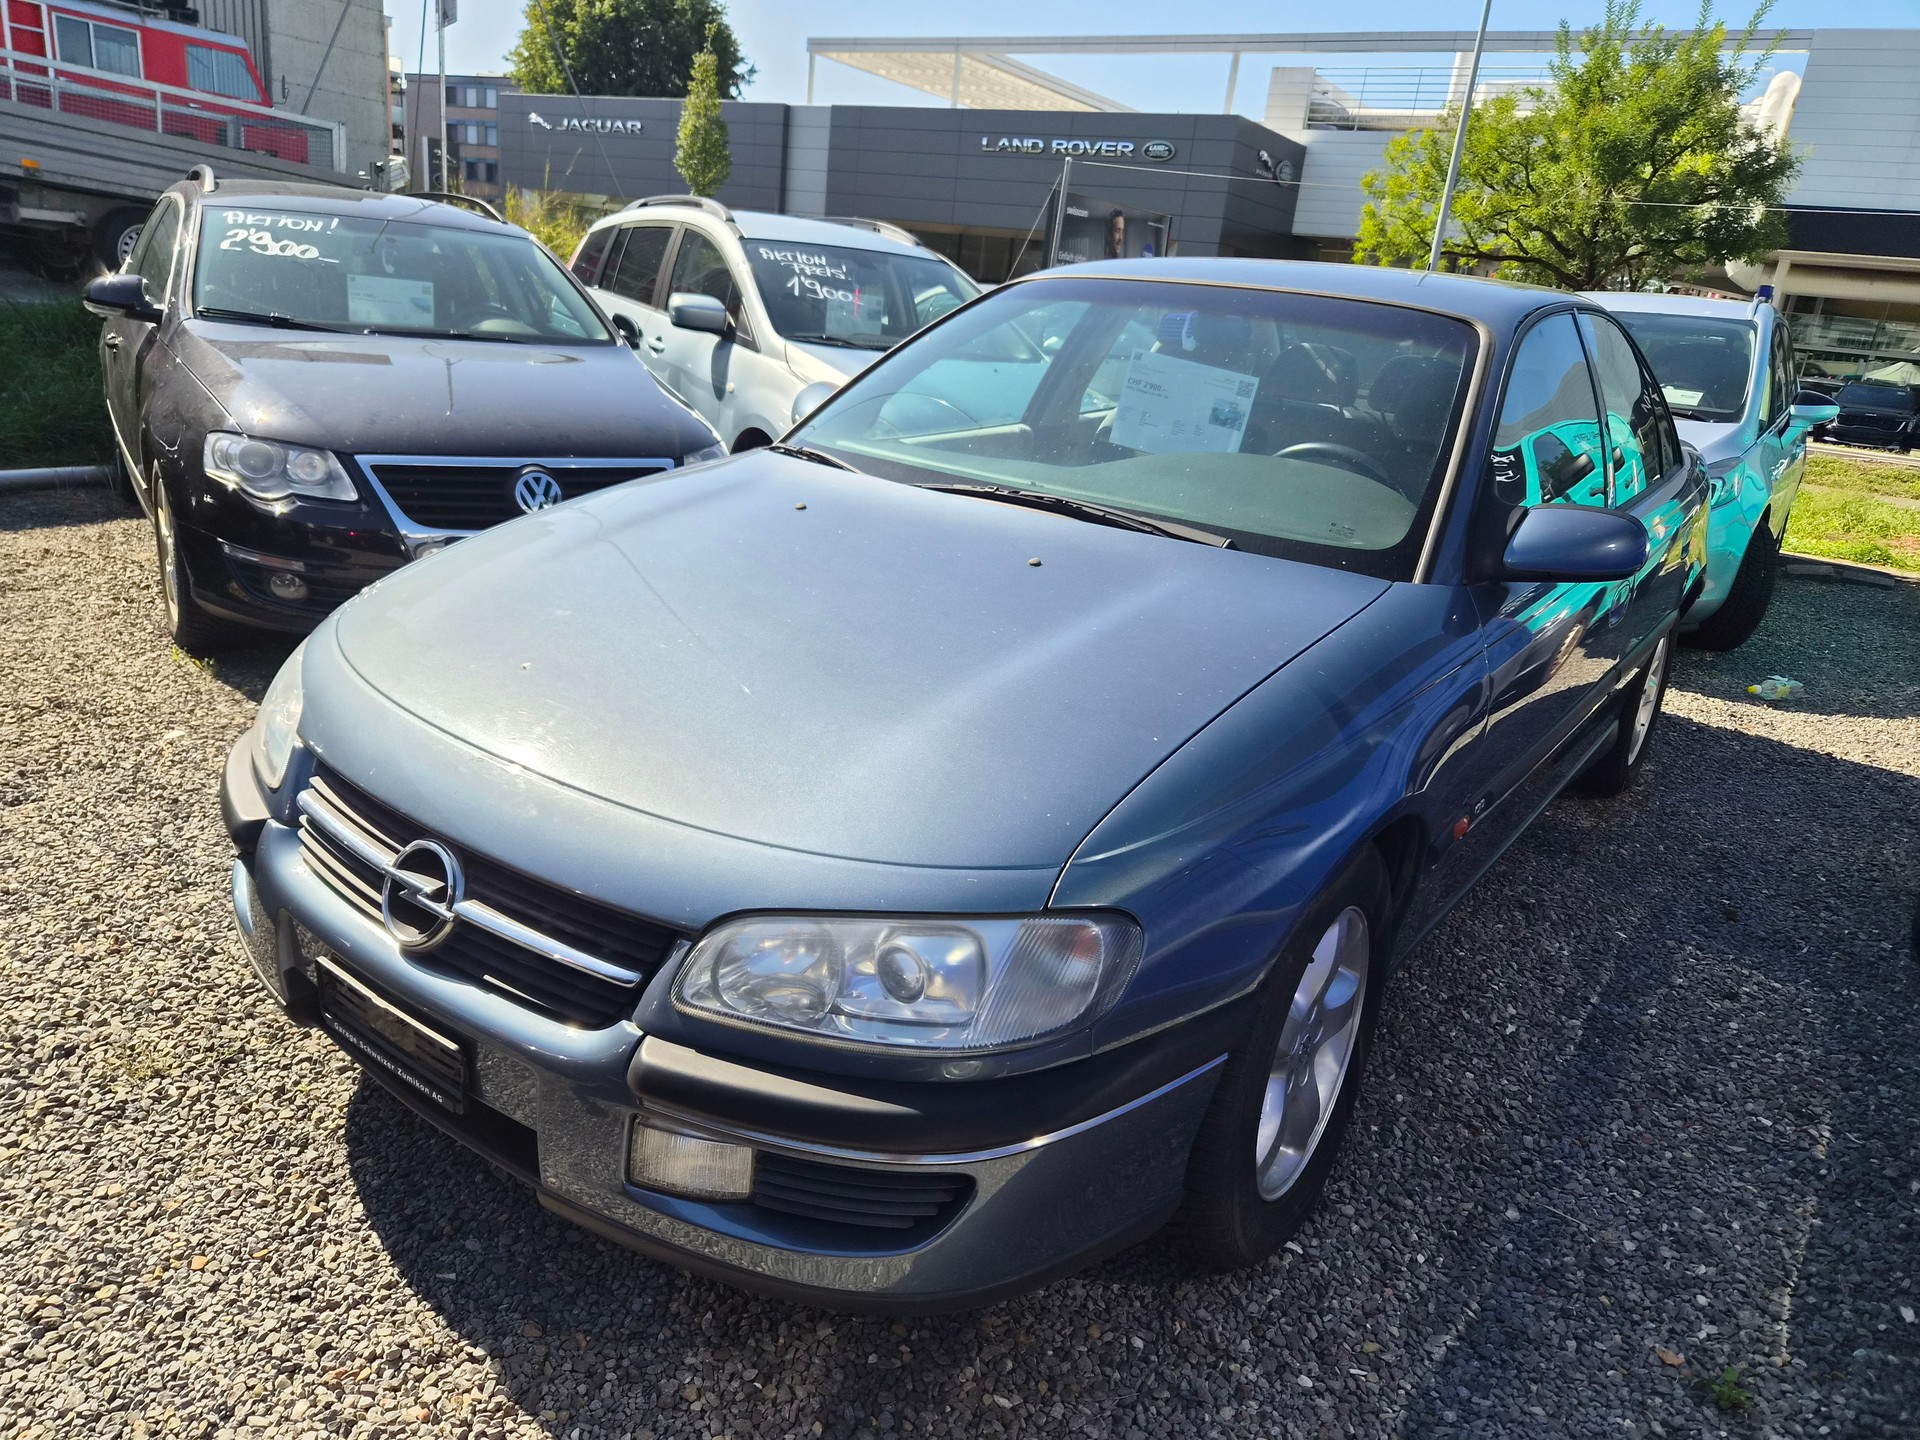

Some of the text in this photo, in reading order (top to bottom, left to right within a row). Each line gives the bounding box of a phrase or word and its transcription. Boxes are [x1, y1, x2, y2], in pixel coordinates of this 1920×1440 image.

[556, 118, 642, 134] JAGUAR
[981, 136, 1134, 158] LAND ROVER
[1066, 206, 1089, 218] swisscom
[759, 247, 826, 265] AKTION
[1127, 377, 1142, 386] CHF
[334, 1022, 444, 1104] Garage Schweizer Zumikon AG
